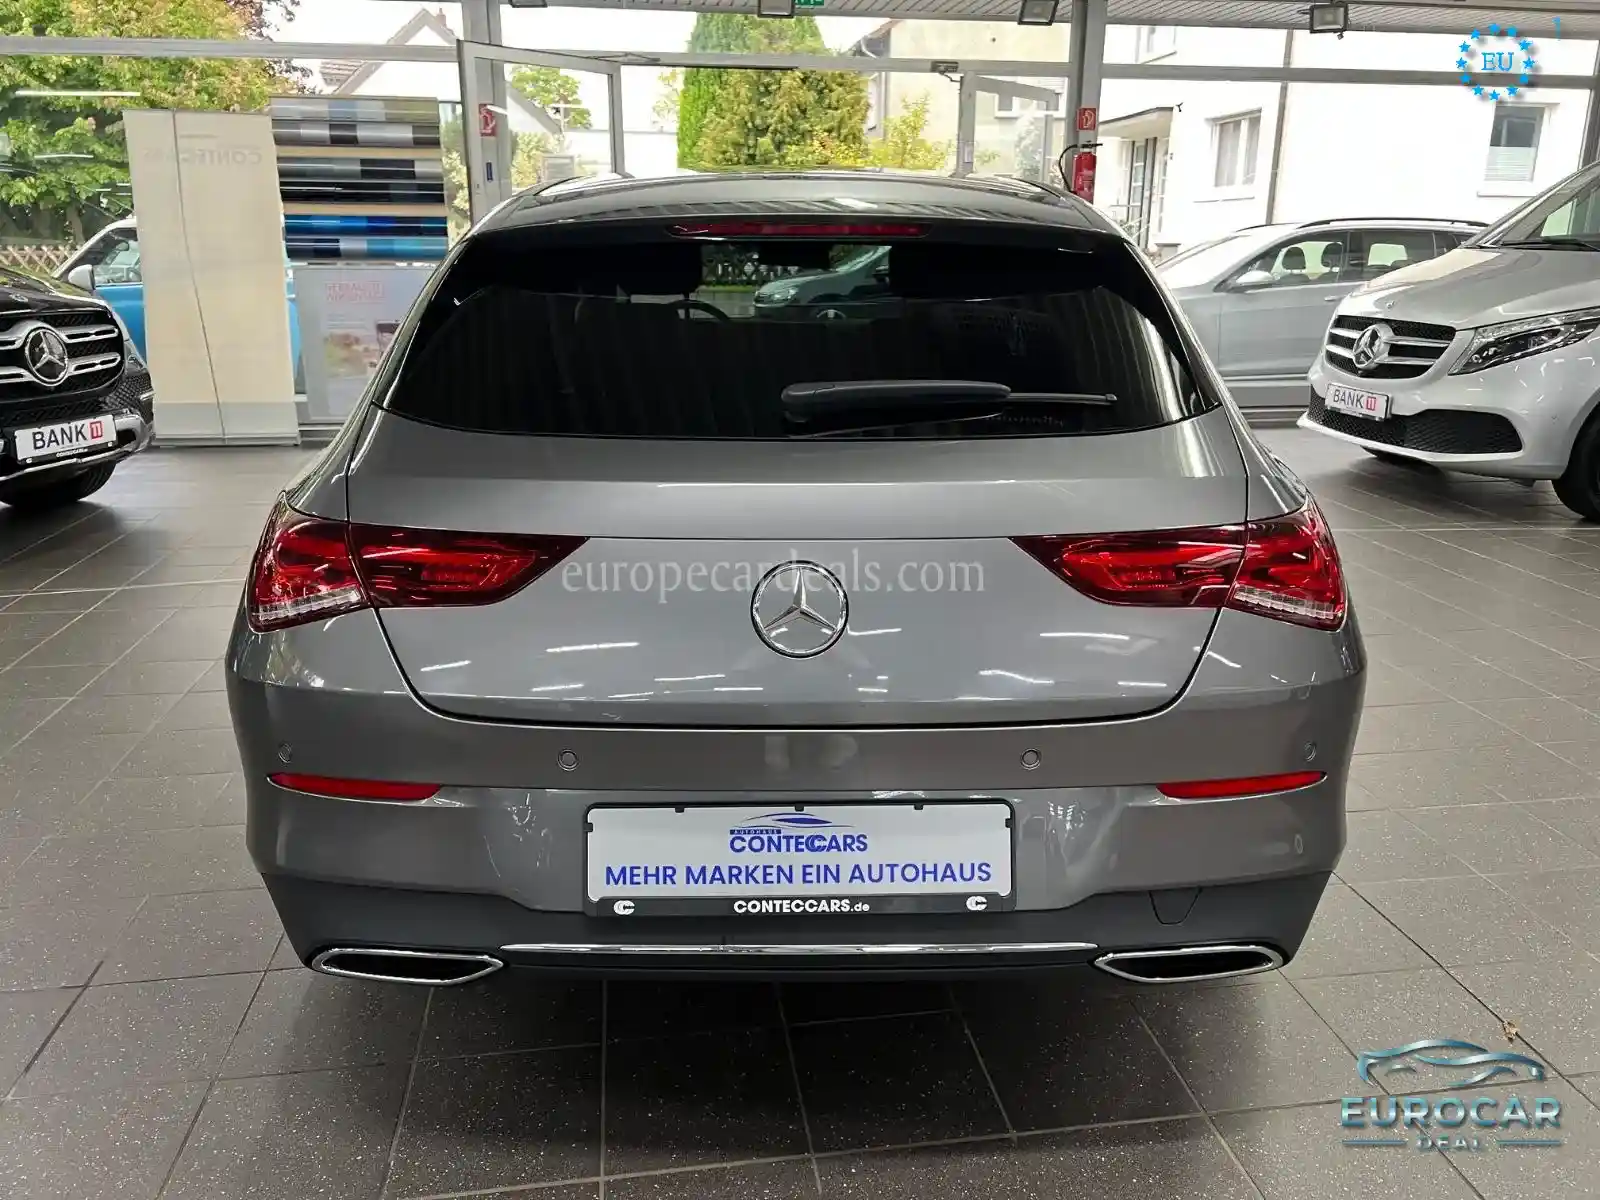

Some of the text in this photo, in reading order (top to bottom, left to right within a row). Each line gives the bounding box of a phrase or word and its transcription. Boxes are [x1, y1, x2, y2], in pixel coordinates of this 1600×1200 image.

[1333, 389, 1364, 409] BANK
[32, 423, 87, 450] BANK
[605, 862, 992, 885] MEHR MARKEN EIN AUTOHAUS
[733, 898, 870, 914] CONTECCARS.de
